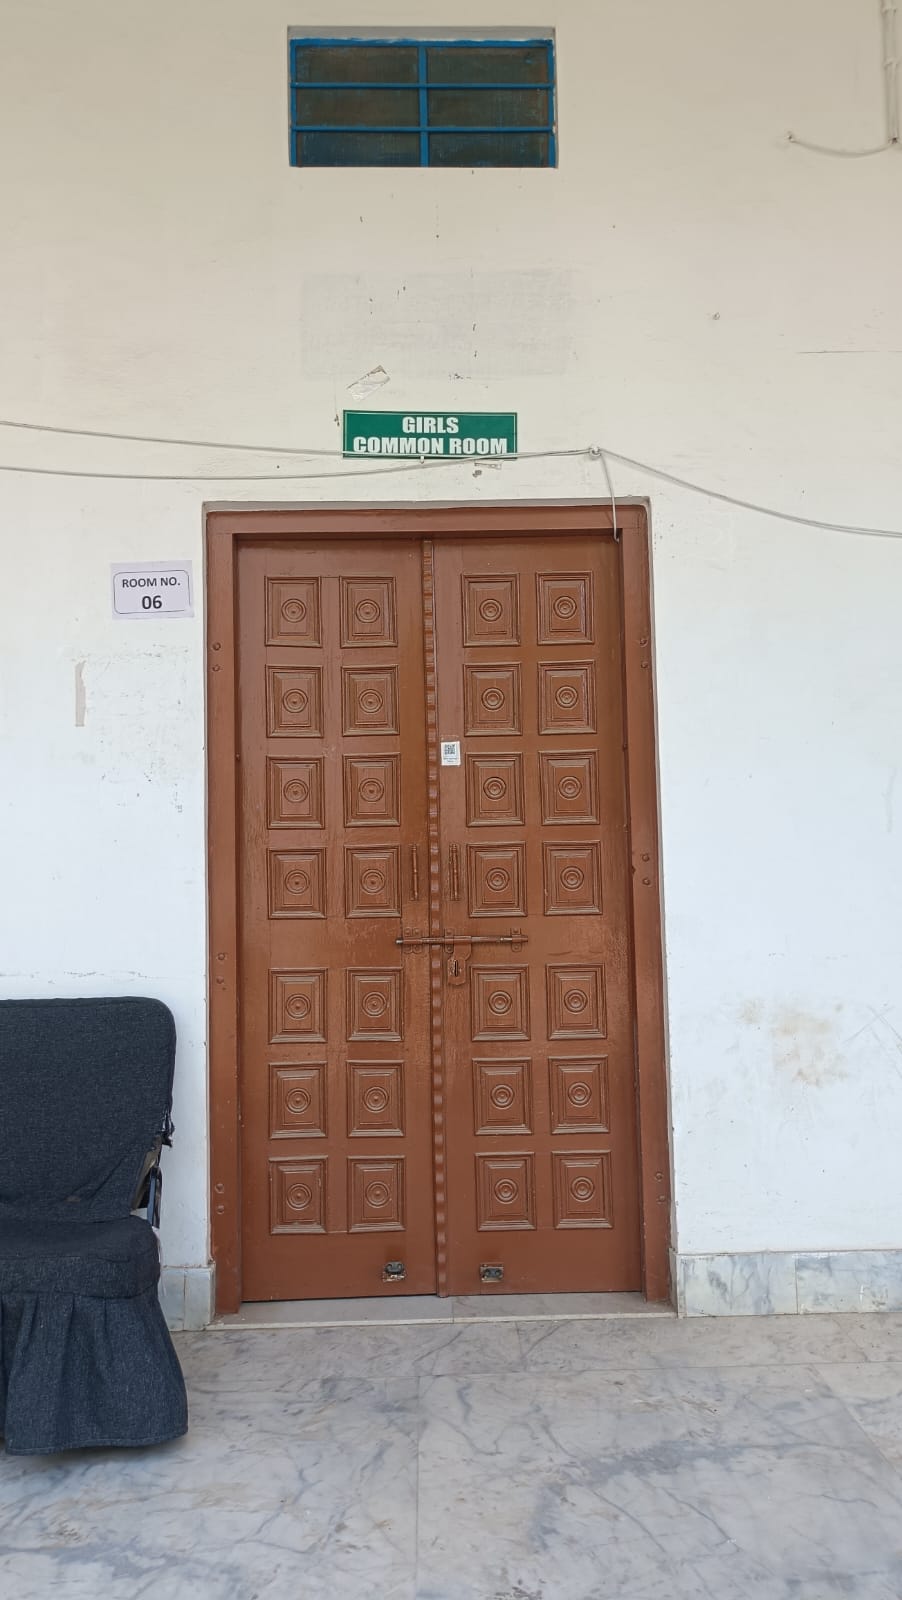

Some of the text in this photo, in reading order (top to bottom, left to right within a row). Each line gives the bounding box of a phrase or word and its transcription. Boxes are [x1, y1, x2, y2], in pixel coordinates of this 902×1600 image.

[402, 416, 459, 434] GIRLS
[353, 436, 507, 455] COMMON ROOM
[122, 576, 181, 588] ROOM NO.
[141, 595, 163, 609] 06
